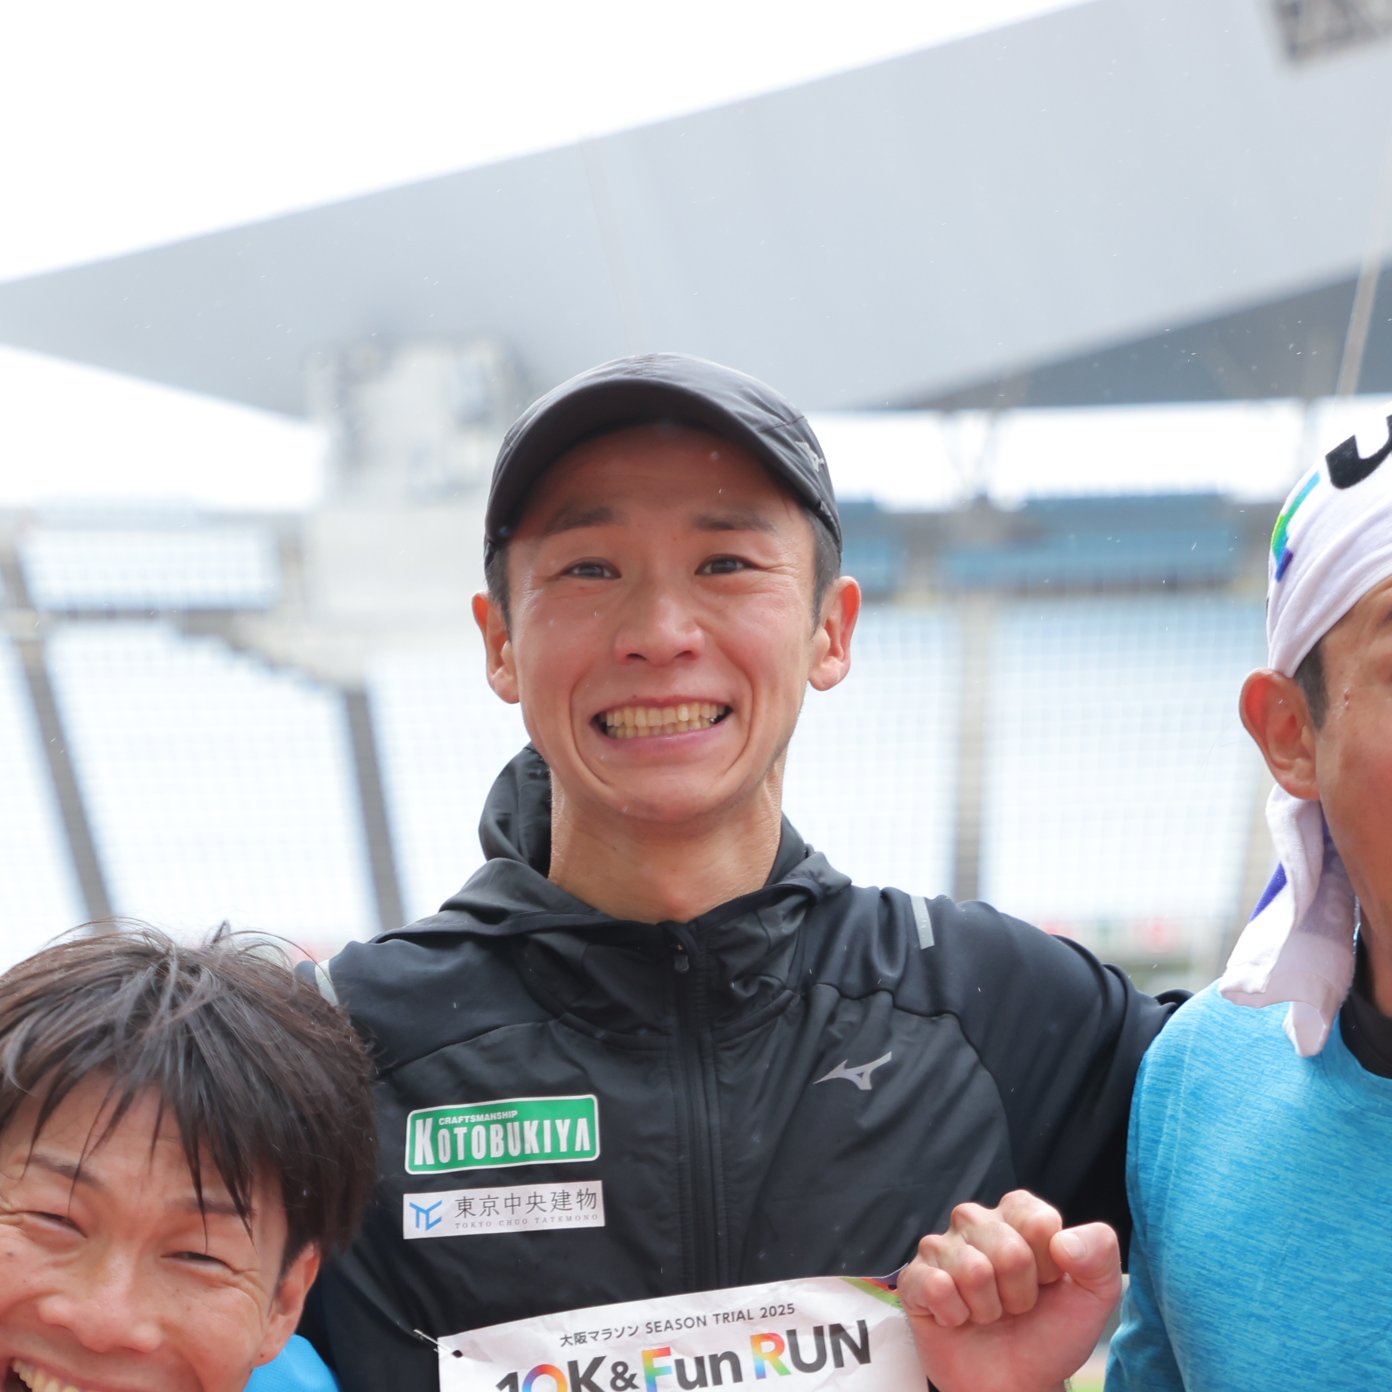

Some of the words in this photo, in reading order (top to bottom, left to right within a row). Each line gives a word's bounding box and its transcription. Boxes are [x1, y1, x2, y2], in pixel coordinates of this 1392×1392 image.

[438, 1110, 518, 1126] CRAFTSMANSHIP
[414, 1117, 591, 1166] KOTOBUKIYA
[454, 1187, 598, 1220] 東京中央建物
[454, 1221, 492, 1229] TOKYO
[498, 1218, 529, 1227] CHUO
[534, 1213, 599, 1224] TATEMONO
[559, 1325, 639, 1348] 大阪マラソン
[645, 1315, 707, 1335] SEASON
[712, 1308, 754, 1325] TRIAL
[759, 1303, 796, 1319] 2025
[750, 1319, 872, 1381] RUN
